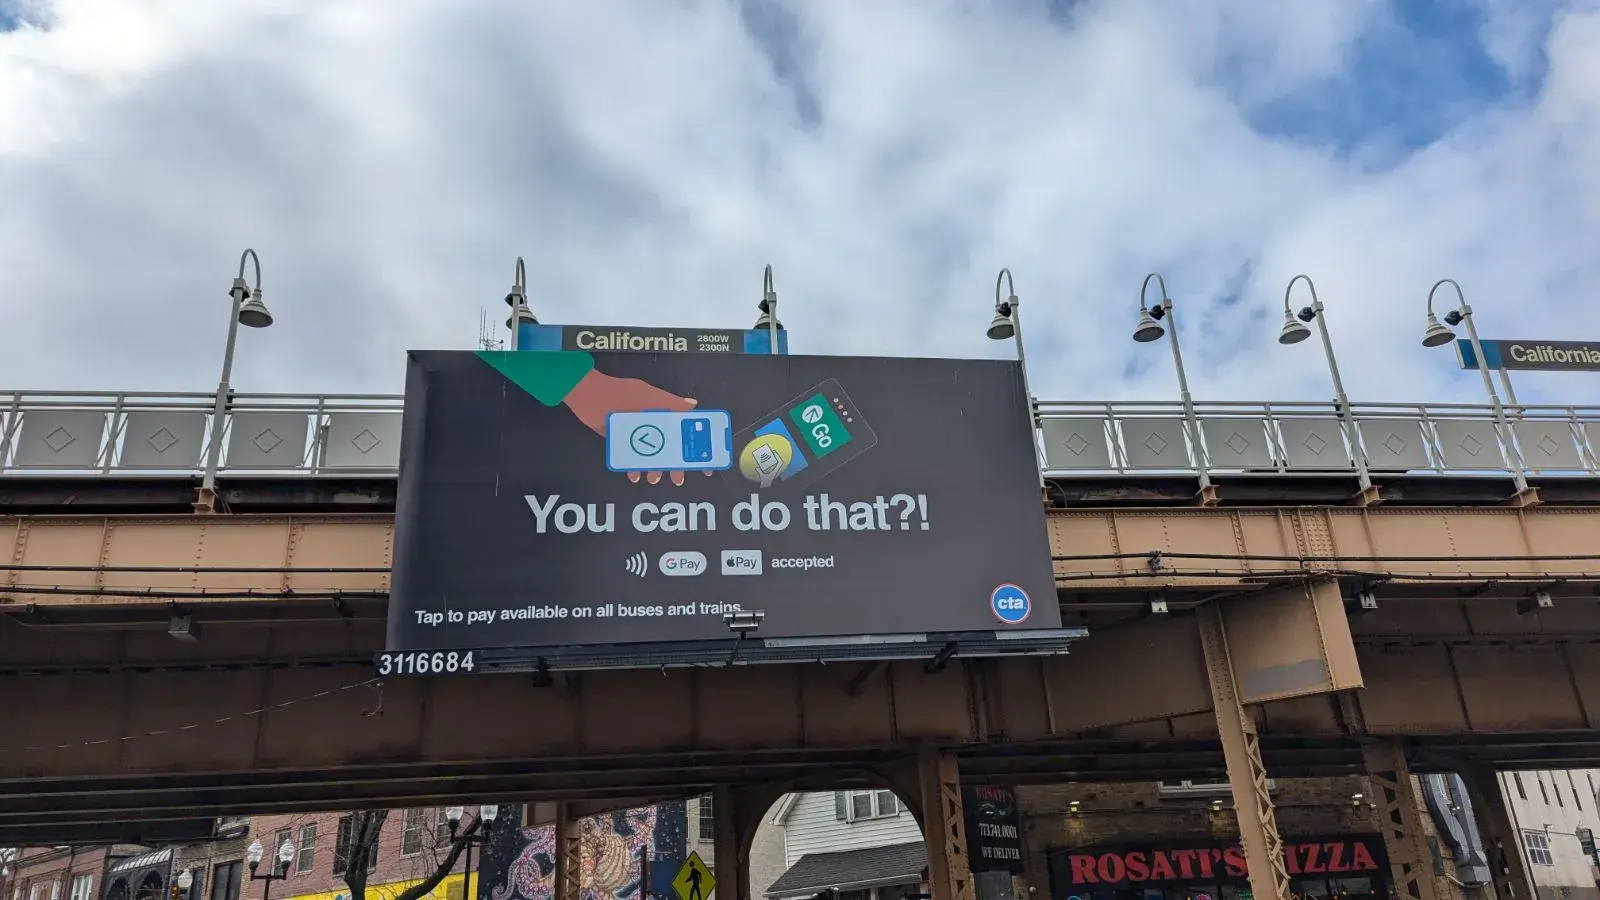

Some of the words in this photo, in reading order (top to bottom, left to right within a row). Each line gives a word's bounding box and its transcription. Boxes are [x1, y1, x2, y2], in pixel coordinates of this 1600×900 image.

[576, 330, 689, 352] California
[697, 334, 729, 342] 2800W
[699, 343, 730, 352] 2300N
[1510, 344, 1600, 363] California
[524, 494, 615, 534] You
[631, 502, 717, 533] can
[731, 493, 791, 531] do
[803, 493, 930, 531] that?!
[679, 558, 701, 571] Pay
[735, 556, 757, 569] Pay
[771, 555, 835, 570] accepted
[997, 596, 1024, 610] cta
[414, 610, 443, 626] Tap
[447, 609, 463, 622] to
[467, 610, 496, 625] pay
[500, 605, 568, 620] available
[572, 607, 591, 618] on
[596, 604, 613, 617] all
[618, 604, 663, 617] buses
[667, 602, 696, 616] and
[379, 650, 475, 675] 3116684
[981, 846, 992, 858] WE
[993, 847, 1021, 860] DELIVER
[1067, 847, 1248, 884] ROSATI'S
[1282, 842, 1378, 874] IZZA
